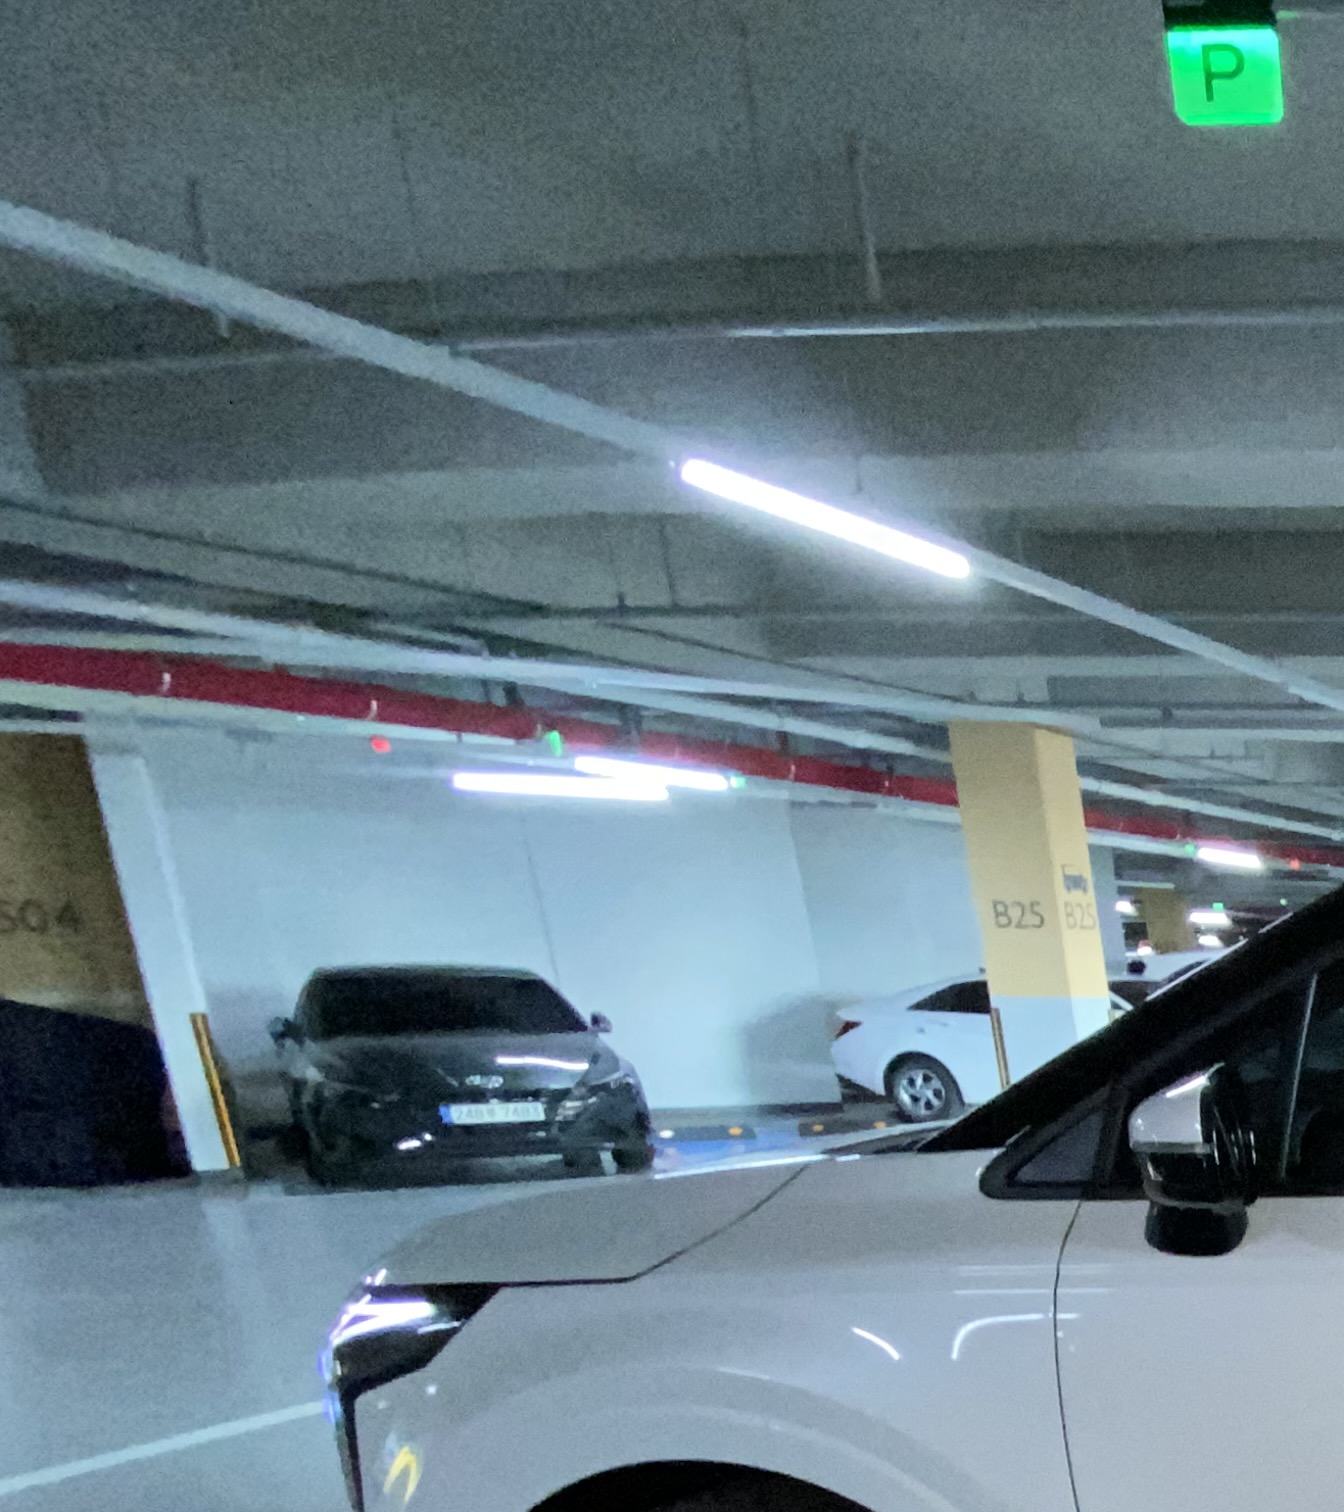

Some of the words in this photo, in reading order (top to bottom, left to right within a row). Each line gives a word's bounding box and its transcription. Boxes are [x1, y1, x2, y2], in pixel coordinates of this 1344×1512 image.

[1201, 43, 1245, 102] P
[992, 899, 1045, 929] B25
[1063, 901, 1097, 929] B25
